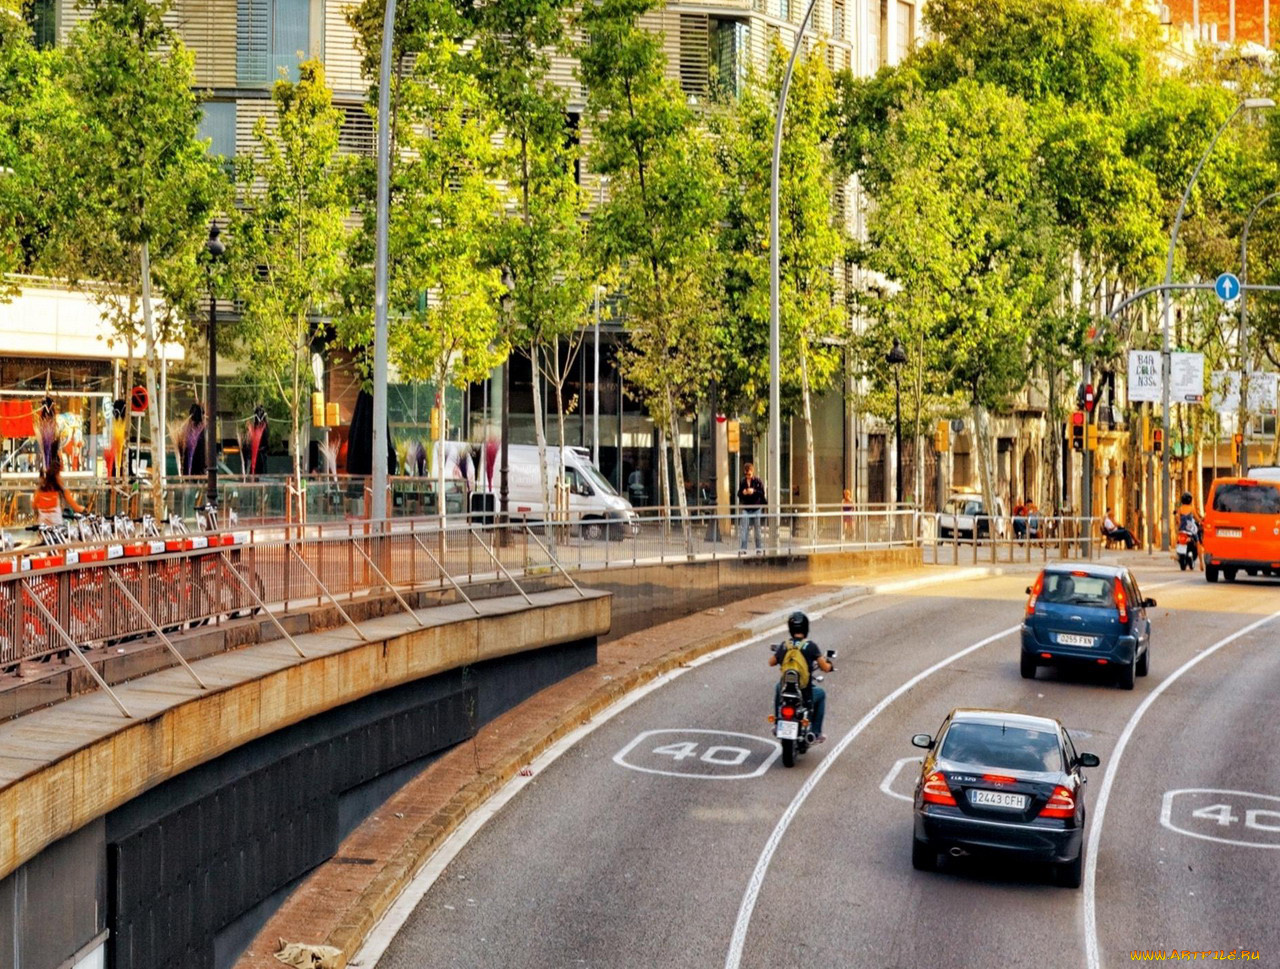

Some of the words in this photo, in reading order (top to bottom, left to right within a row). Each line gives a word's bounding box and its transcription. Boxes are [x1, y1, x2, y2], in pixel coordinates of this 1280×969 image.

[651, 741, 752, 766] 40
[978, 792, 1002, 804] 2443
[1004, 795, 1024, 806] CFH
[1192, 803, 1280, 832] 40
